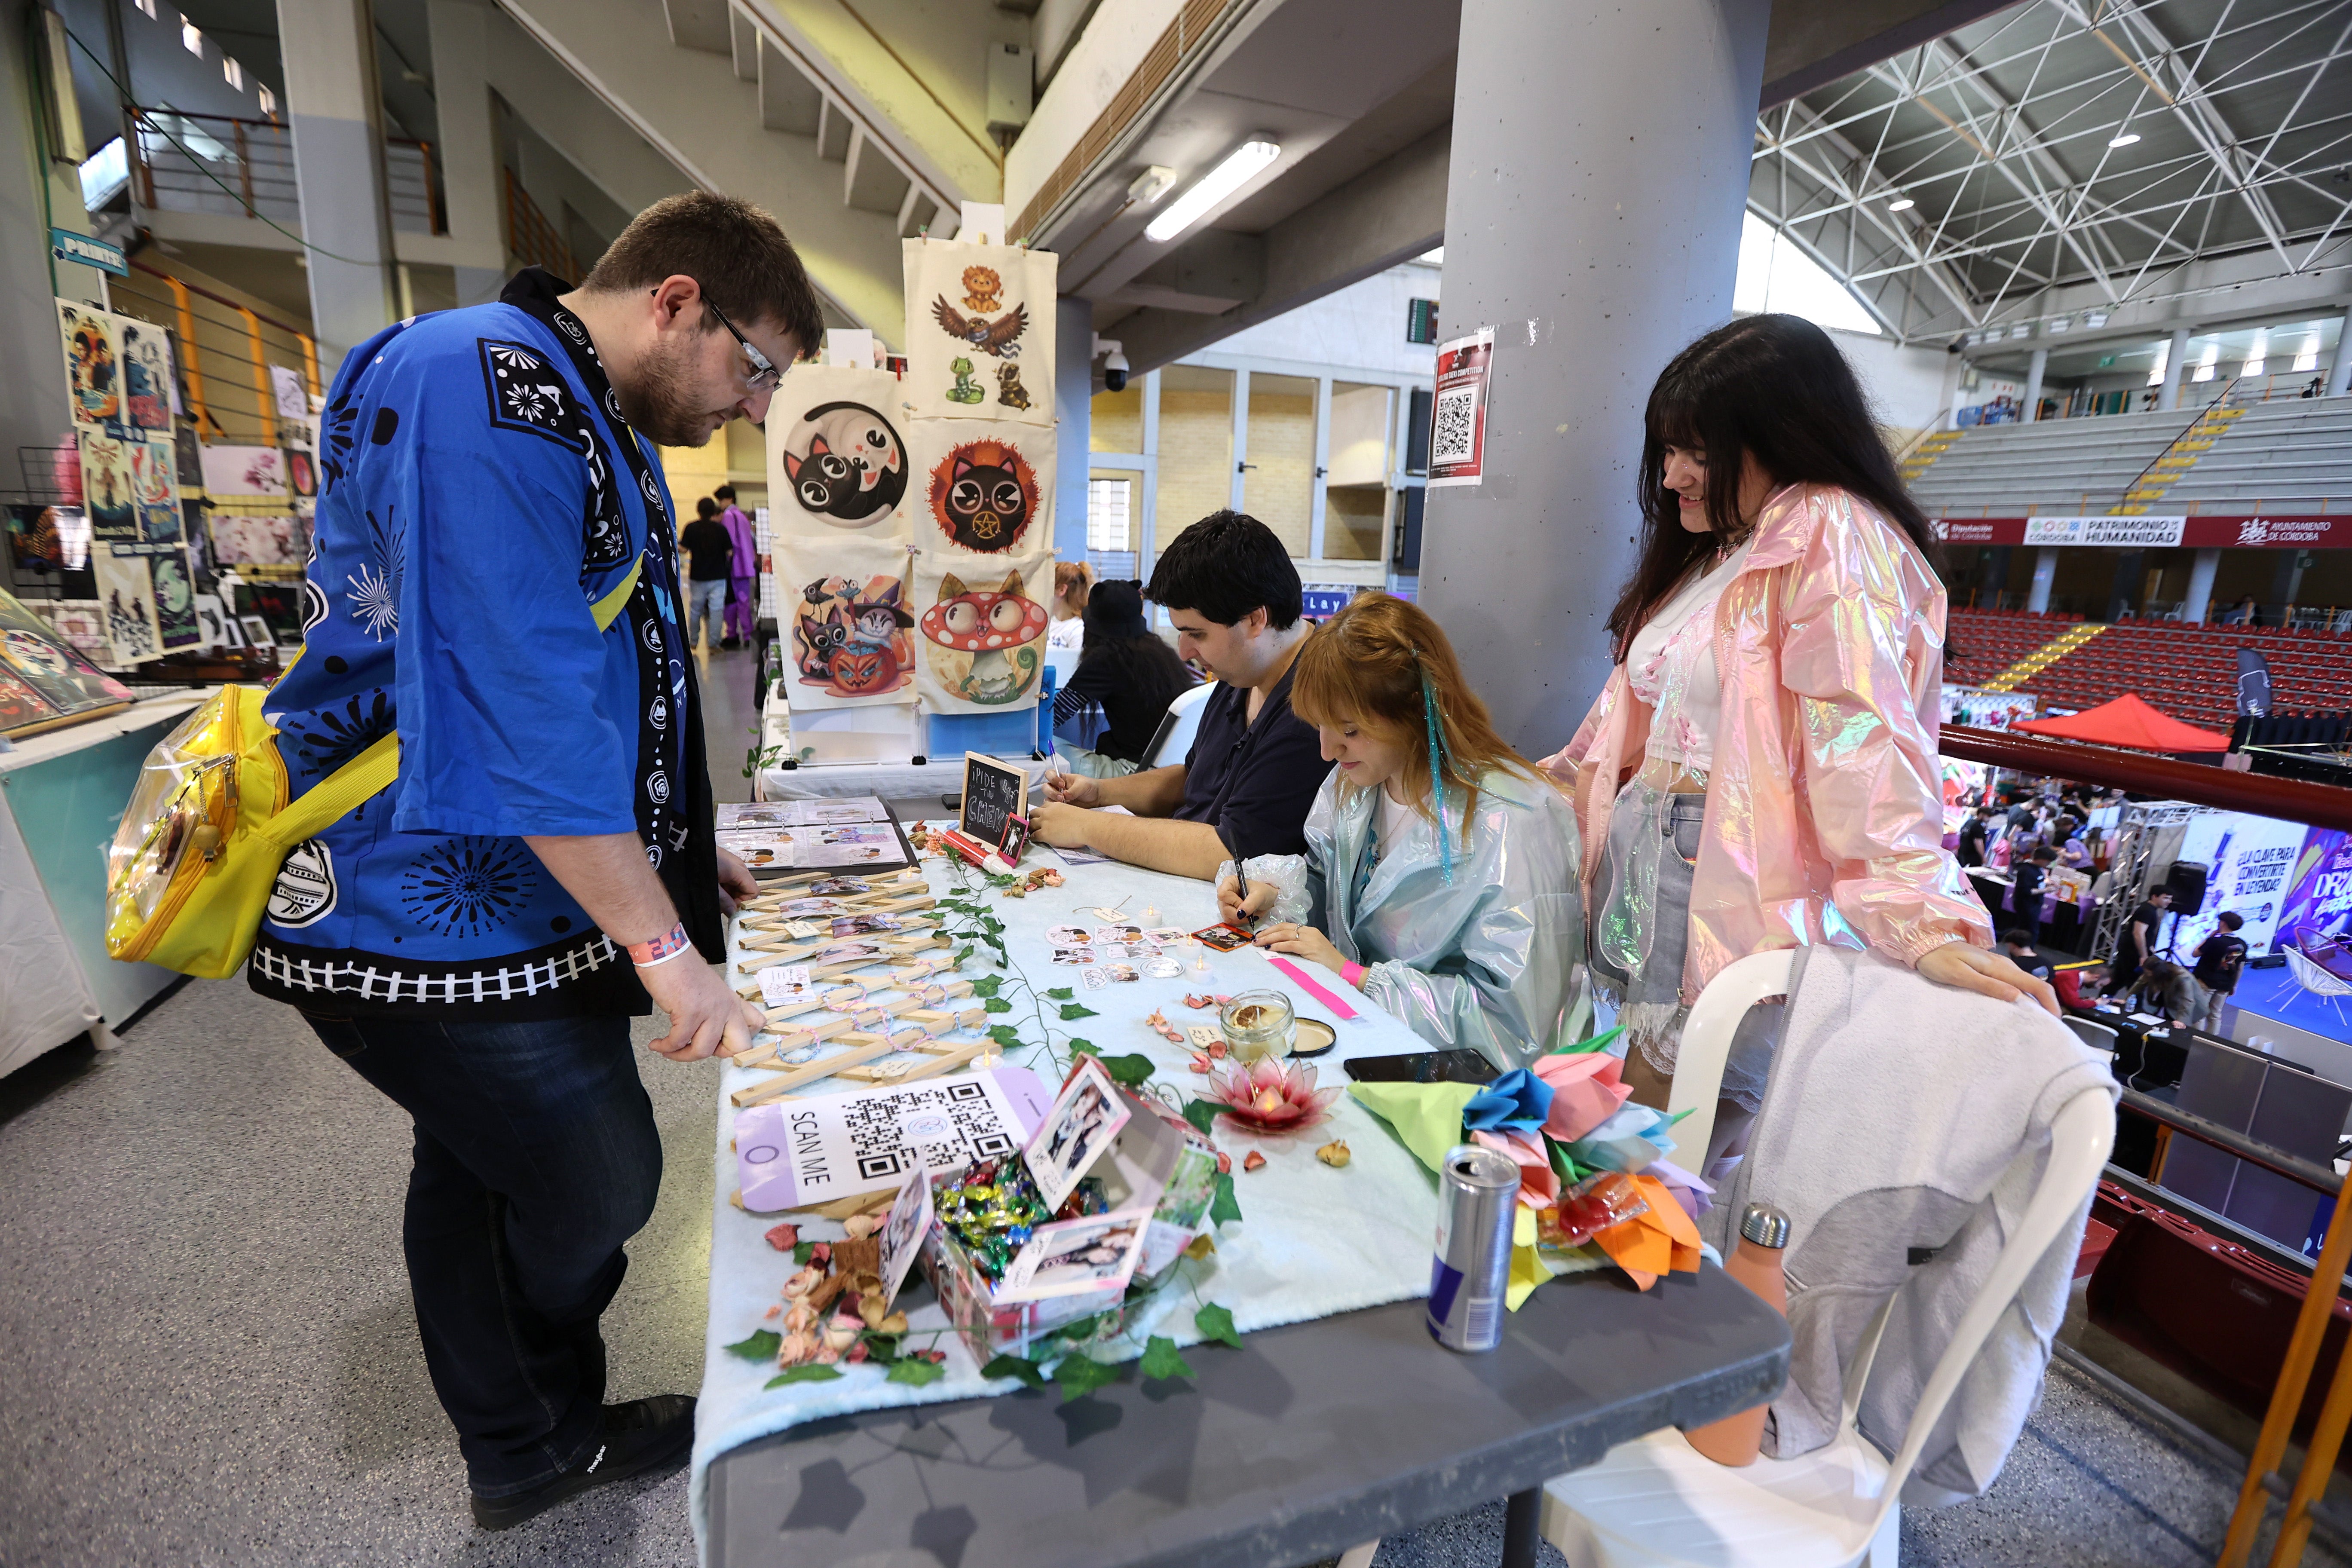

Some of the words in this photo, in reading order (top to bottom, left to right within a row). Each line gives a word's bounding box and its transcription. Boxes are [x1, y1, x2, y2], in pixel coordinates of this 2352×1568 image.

[2088, 520, 2169, 531] PATRIMONIO
[2269, 521, 2331, 531] AYUNTAMIENTO
[2084, 532, 2177, 543] HUMANIDAD
[2268, 532, 2279, 541] DE
[2253, 848, 2277, 864] CLAVE
[2276, 846, 2297, 861] PARA
[2238, 862, 2288, 880] CONVERTIRTE
[2234, 882, 2245, 896] EN
[2245, 878, 2282, 895] LEYENDA?
[791, 1112, 823, 1155] SCAN
[800, 1157, 830, 1187] ME
